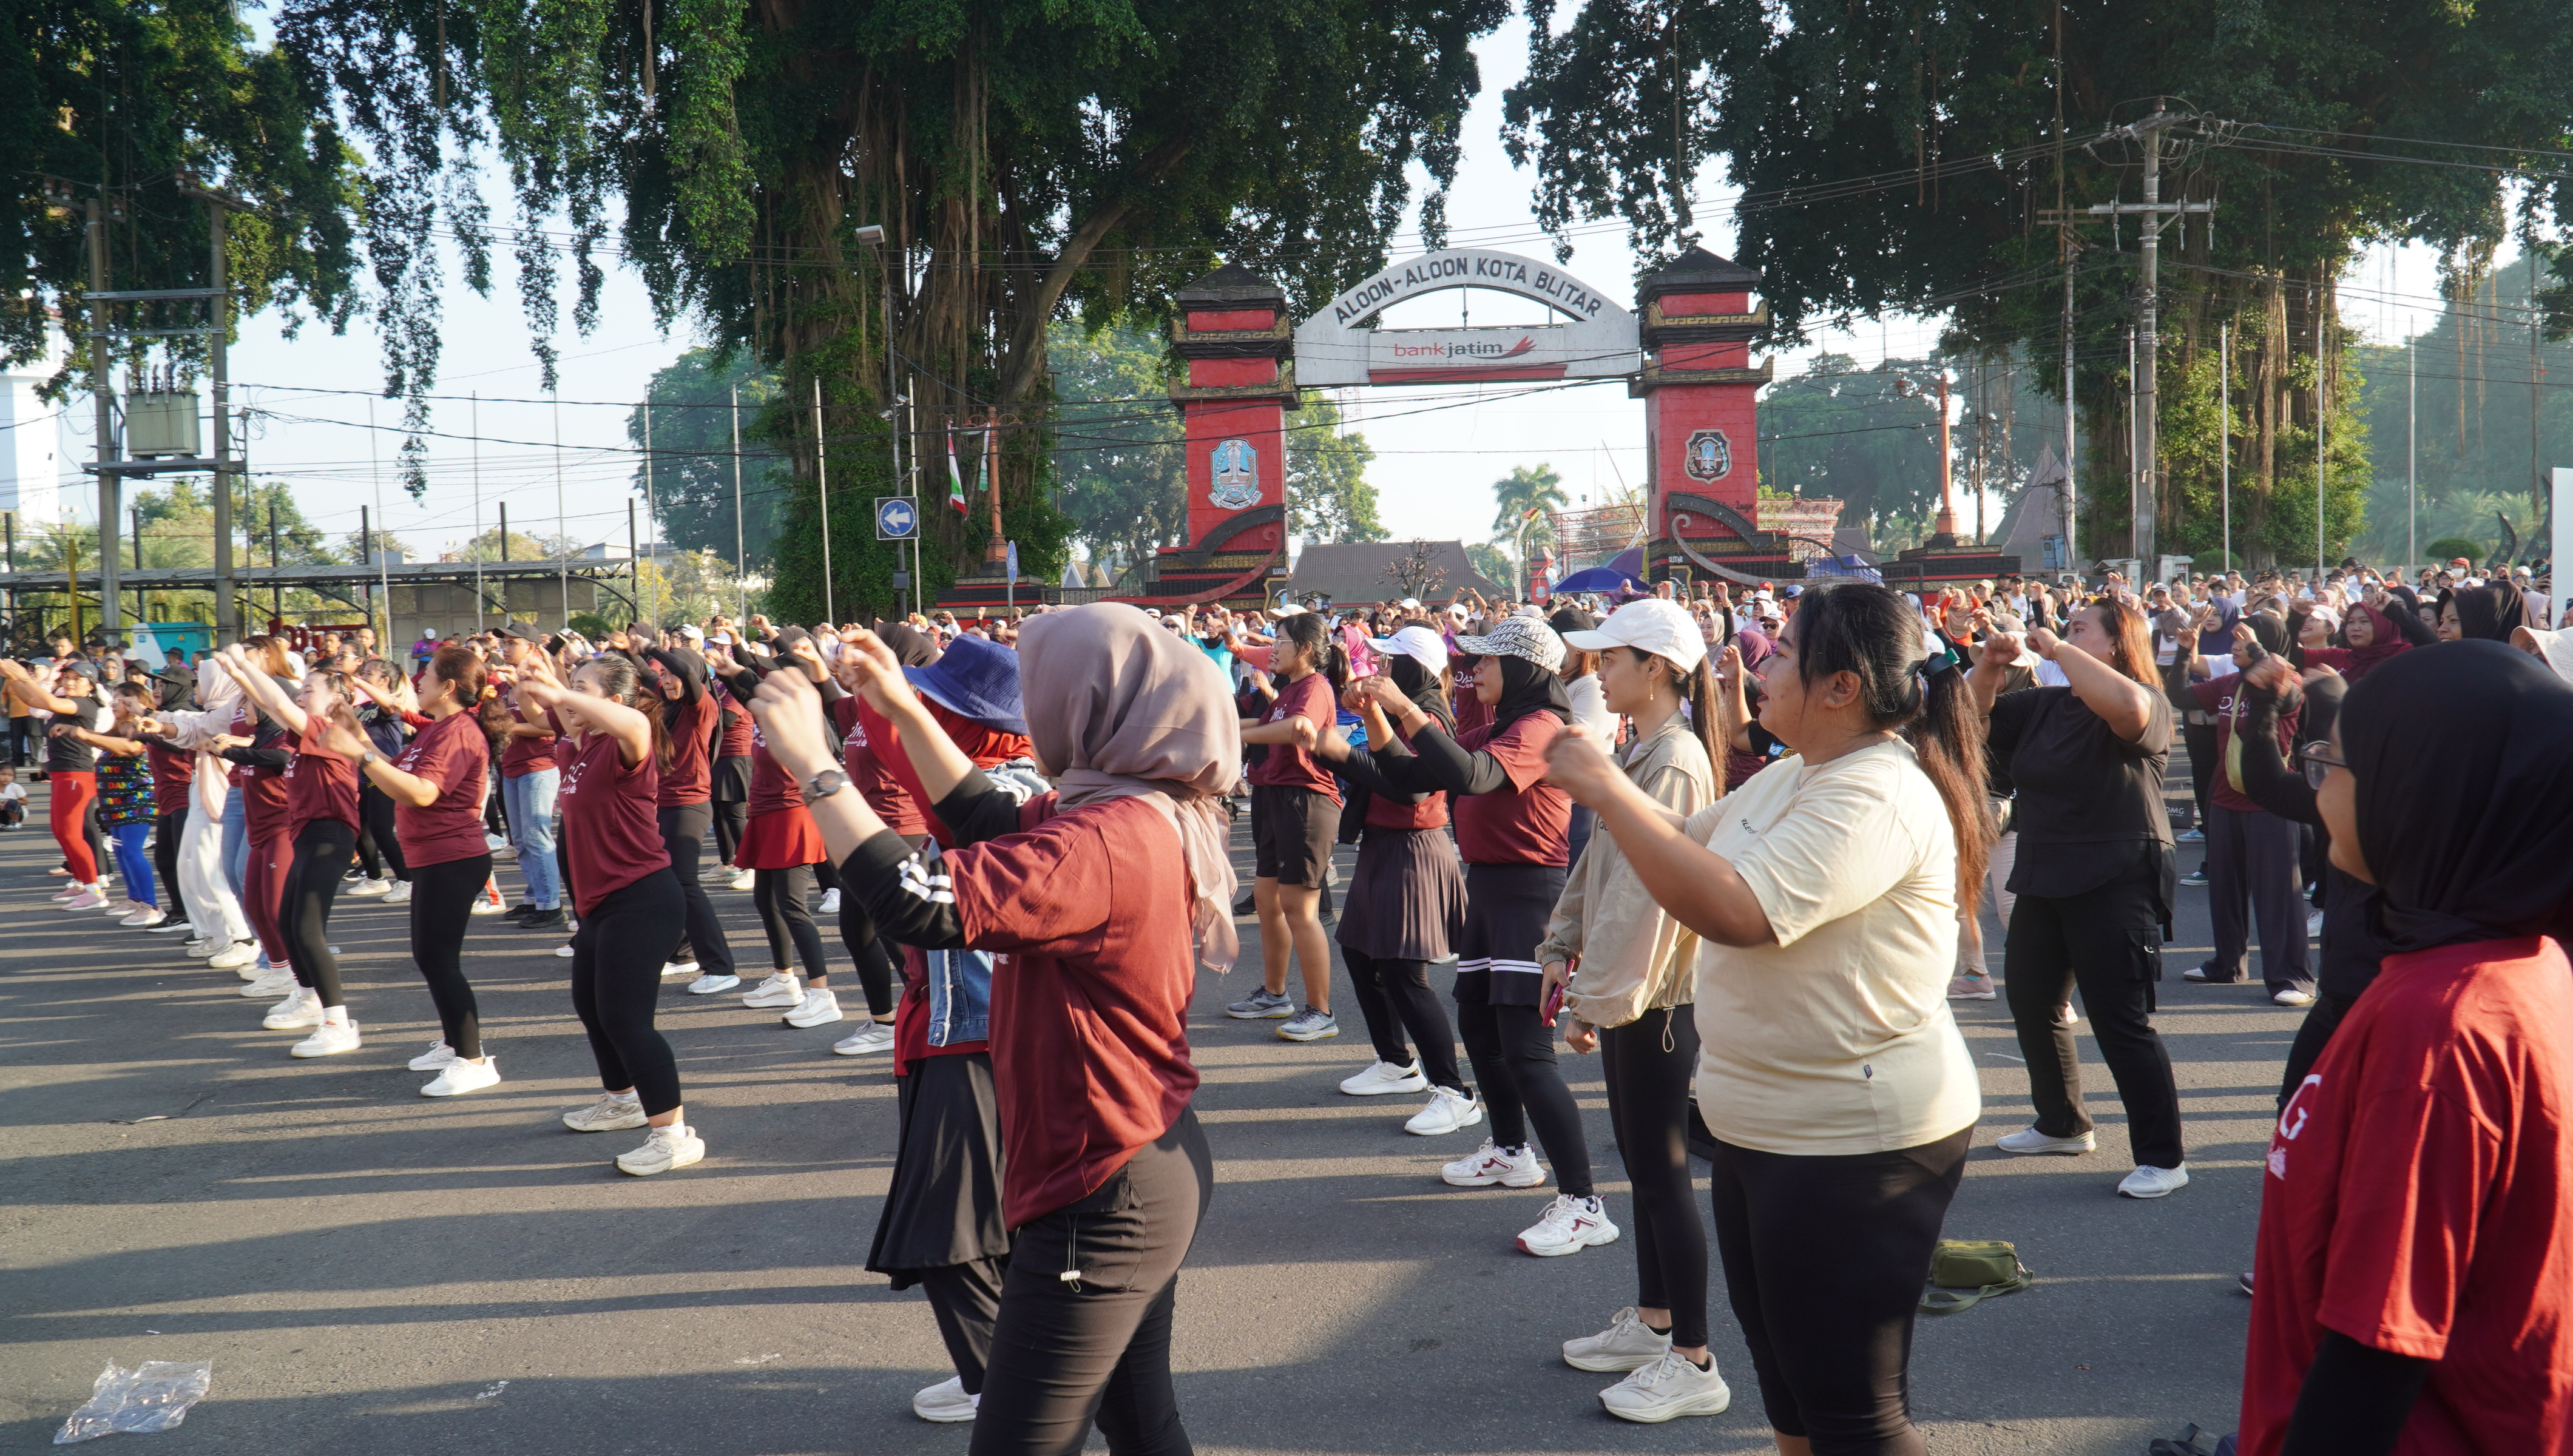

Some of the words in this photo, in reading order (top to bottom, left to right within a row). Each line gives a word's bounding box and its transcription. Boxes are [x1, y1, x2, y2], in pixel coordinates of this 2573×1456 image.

[1335, 257, 1468, 325] ALOON-ALOON
[1476, 258, 1526, 283] KOTA
[1535, 271, 1602, 317] BLITAR
[2279, 1074, 2322, 1140] G
